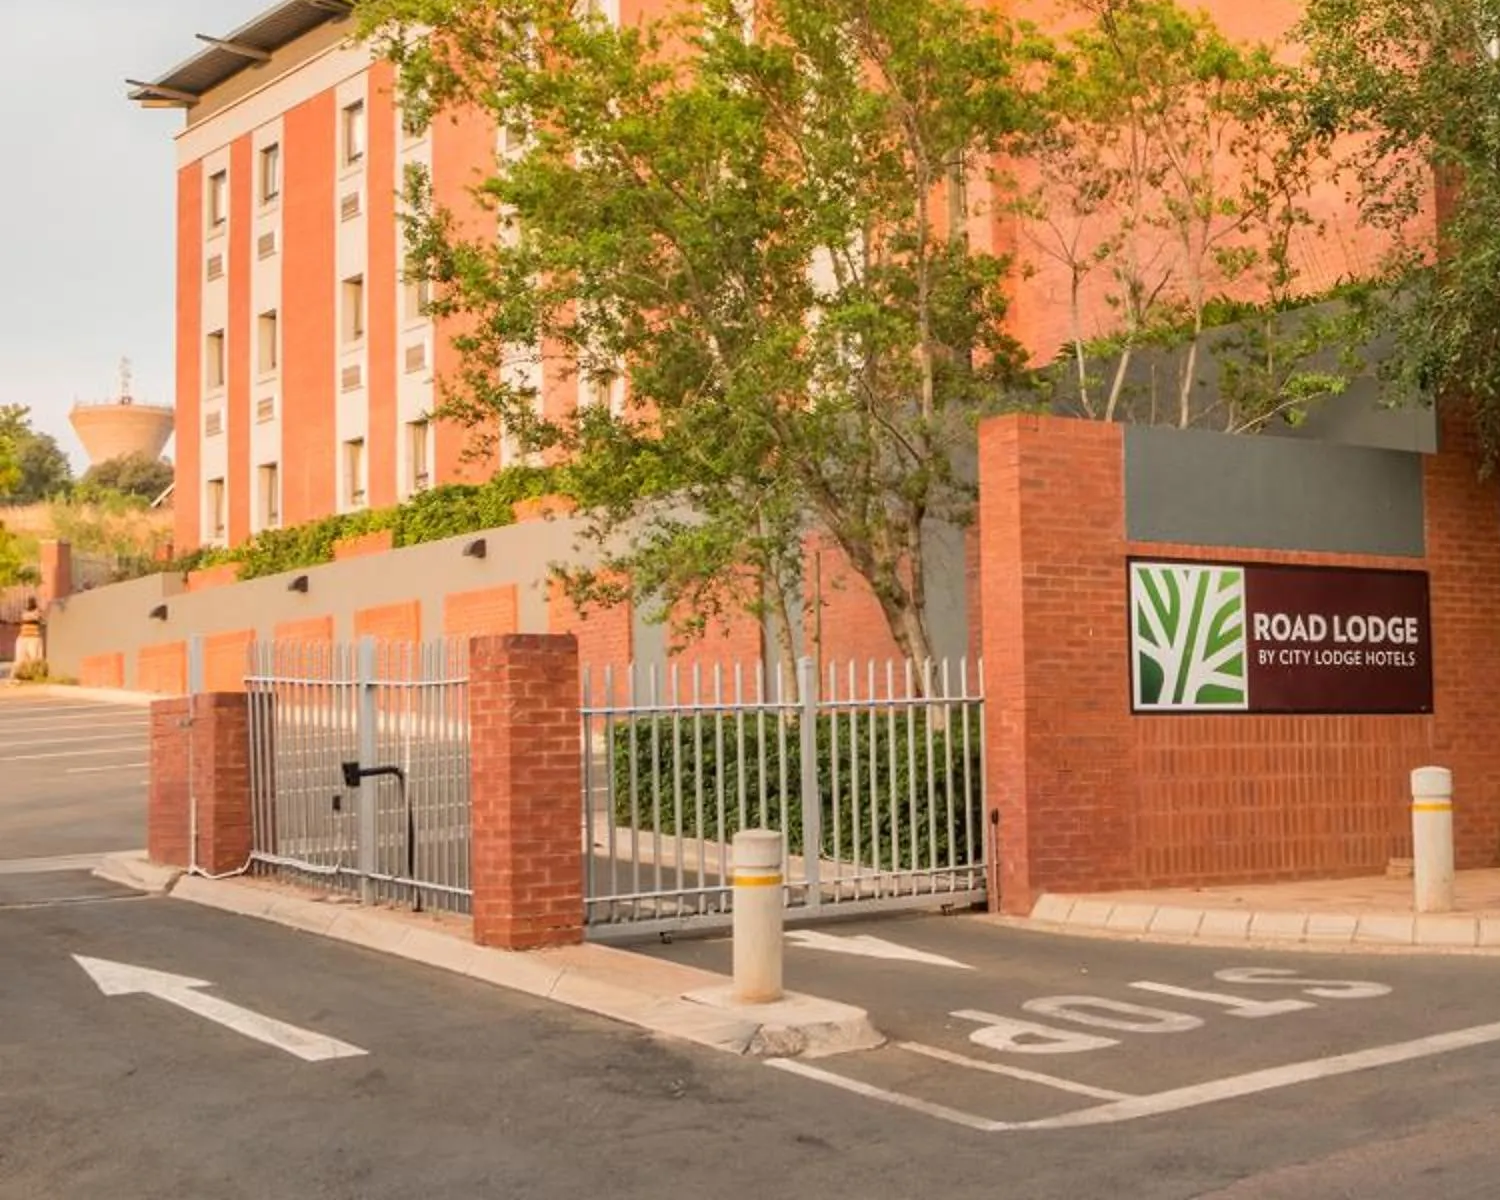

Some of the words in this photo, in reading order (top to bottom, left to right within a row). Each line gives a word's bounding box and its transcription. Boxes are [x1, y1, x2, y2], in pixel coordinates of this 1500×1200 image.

[1253, 612, 1327, 642] ROAD
[1333, 615, 1419, 644] LODGE
[1259, 649, 1276, 665] BY
[1279, 650, 1311, 666] CITY
[1315, 650, 1362, 666] LODGE
[1365, 651, 1416, 667] HOTELS
[950, 966, 1393, 1054] STOP
